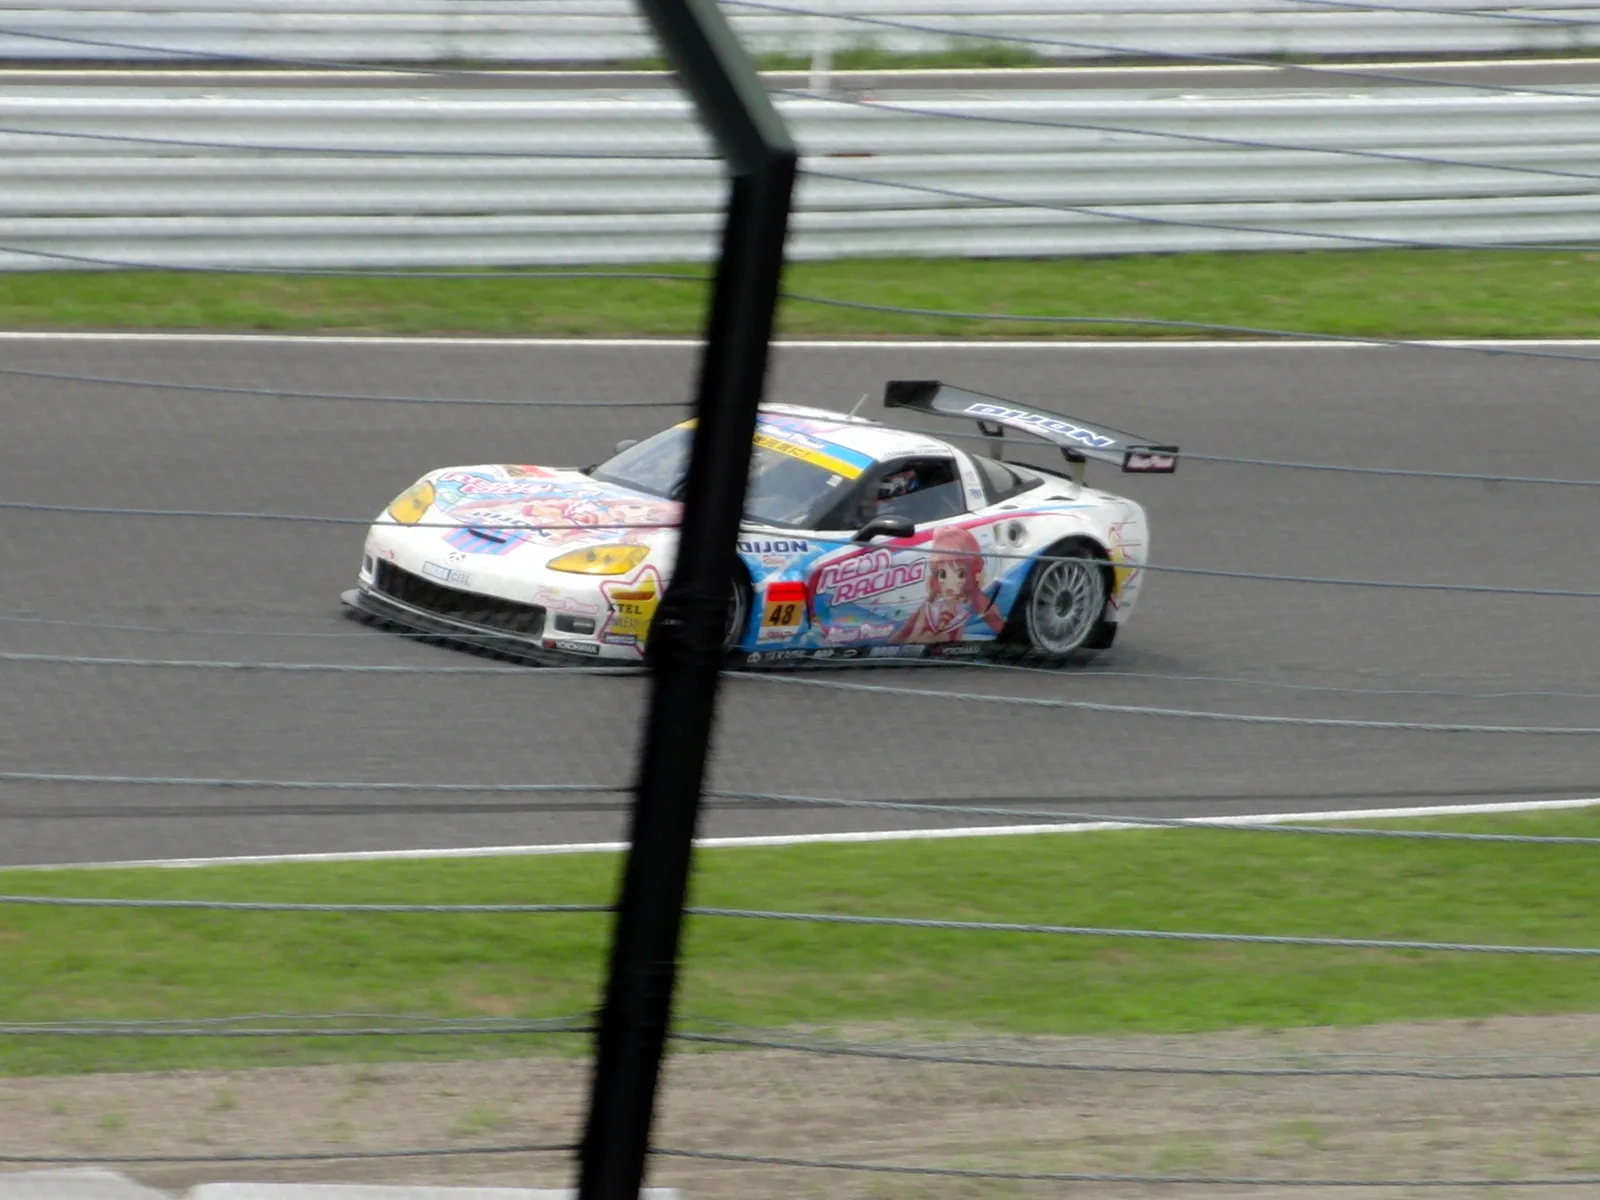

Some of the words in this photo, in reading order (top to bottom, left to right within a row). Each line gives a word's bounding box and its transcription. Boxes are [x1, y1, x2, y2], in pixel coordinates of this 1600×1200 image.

[964, 403, 1117, 447] DIJON
[738, 540, 809, 554] DIJON
[831, 557, 927, 607] RACING
[767, 603, 796, 626] 48
